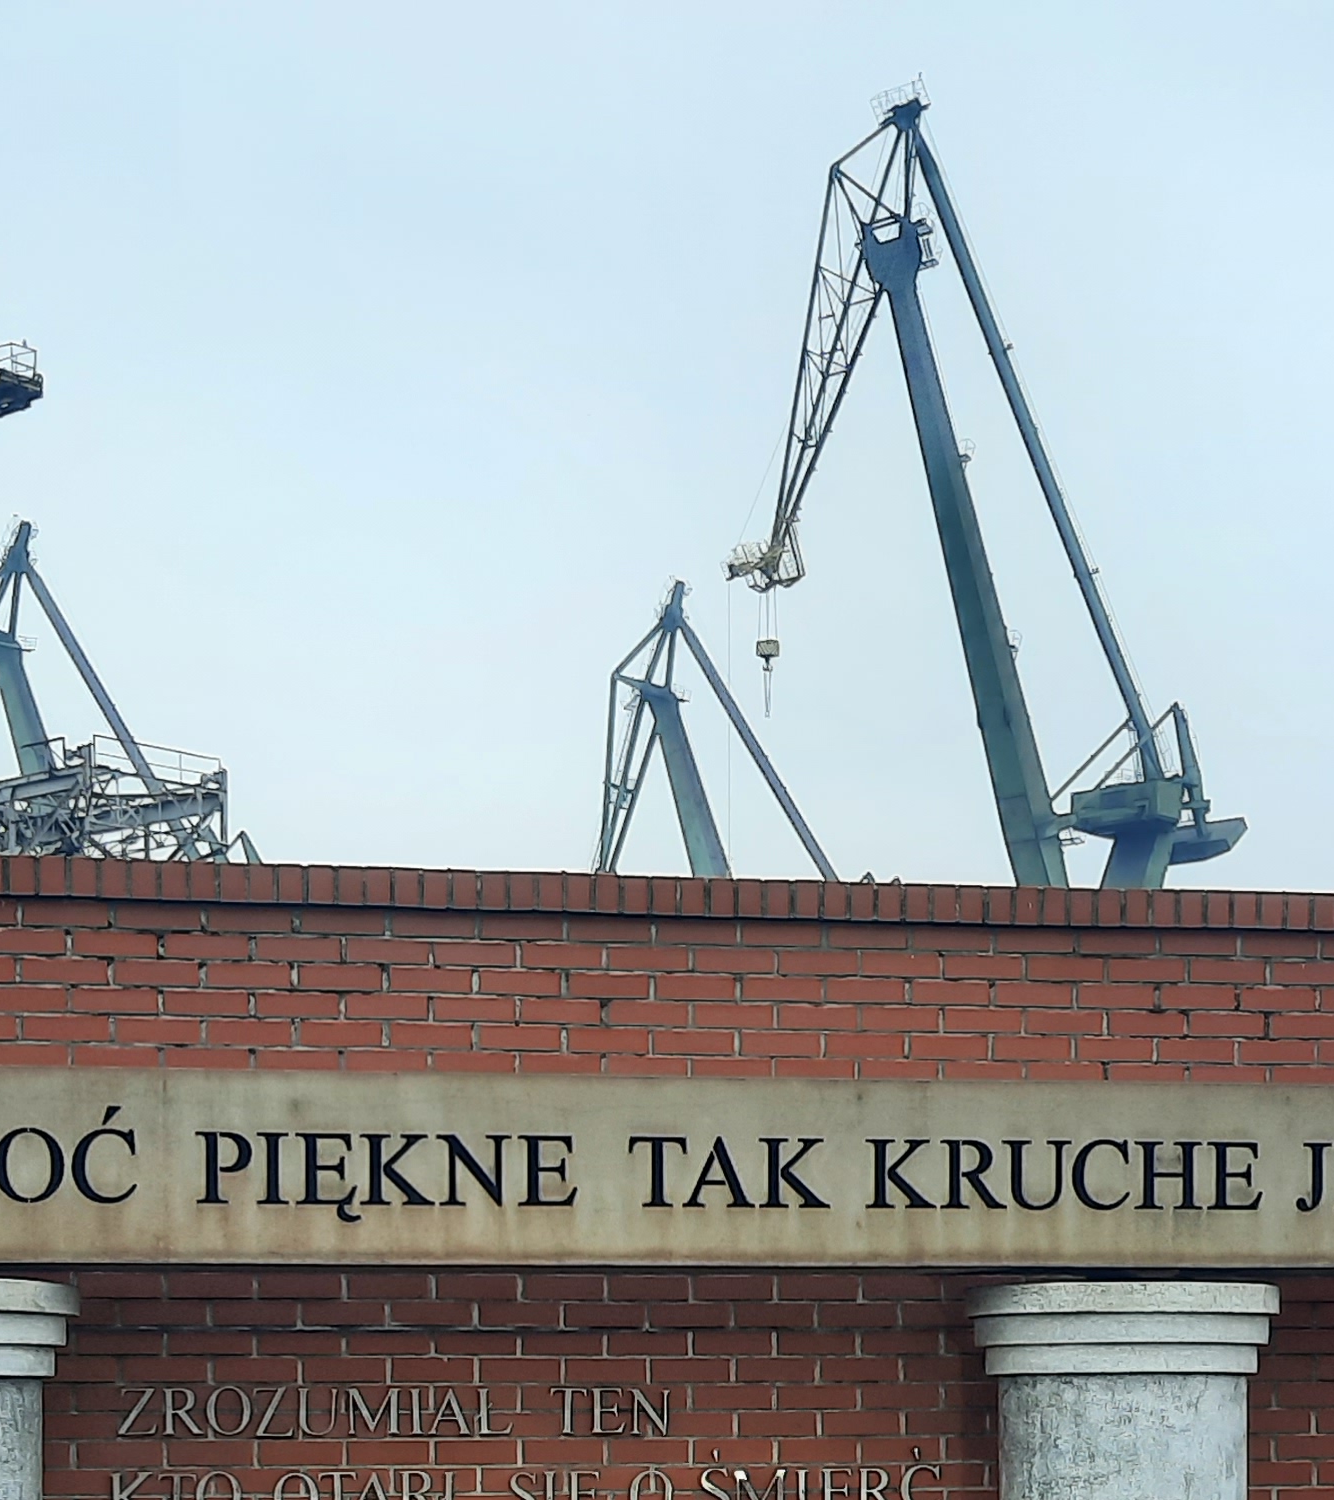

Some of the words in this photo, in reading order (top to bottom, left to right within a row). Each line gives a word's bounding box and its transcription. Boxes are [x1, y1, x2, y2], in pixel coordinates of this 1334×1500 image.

[195, 1130, 577, 1223] PIĘKNE
[628, 1134, 830, 1210] TAK
[866, 1137, 1264, 1212] KRUCHE
[116, 1385, 513, 1438] ZROZUMIAŁ
[549, 1386, 670, 1437] TEN
